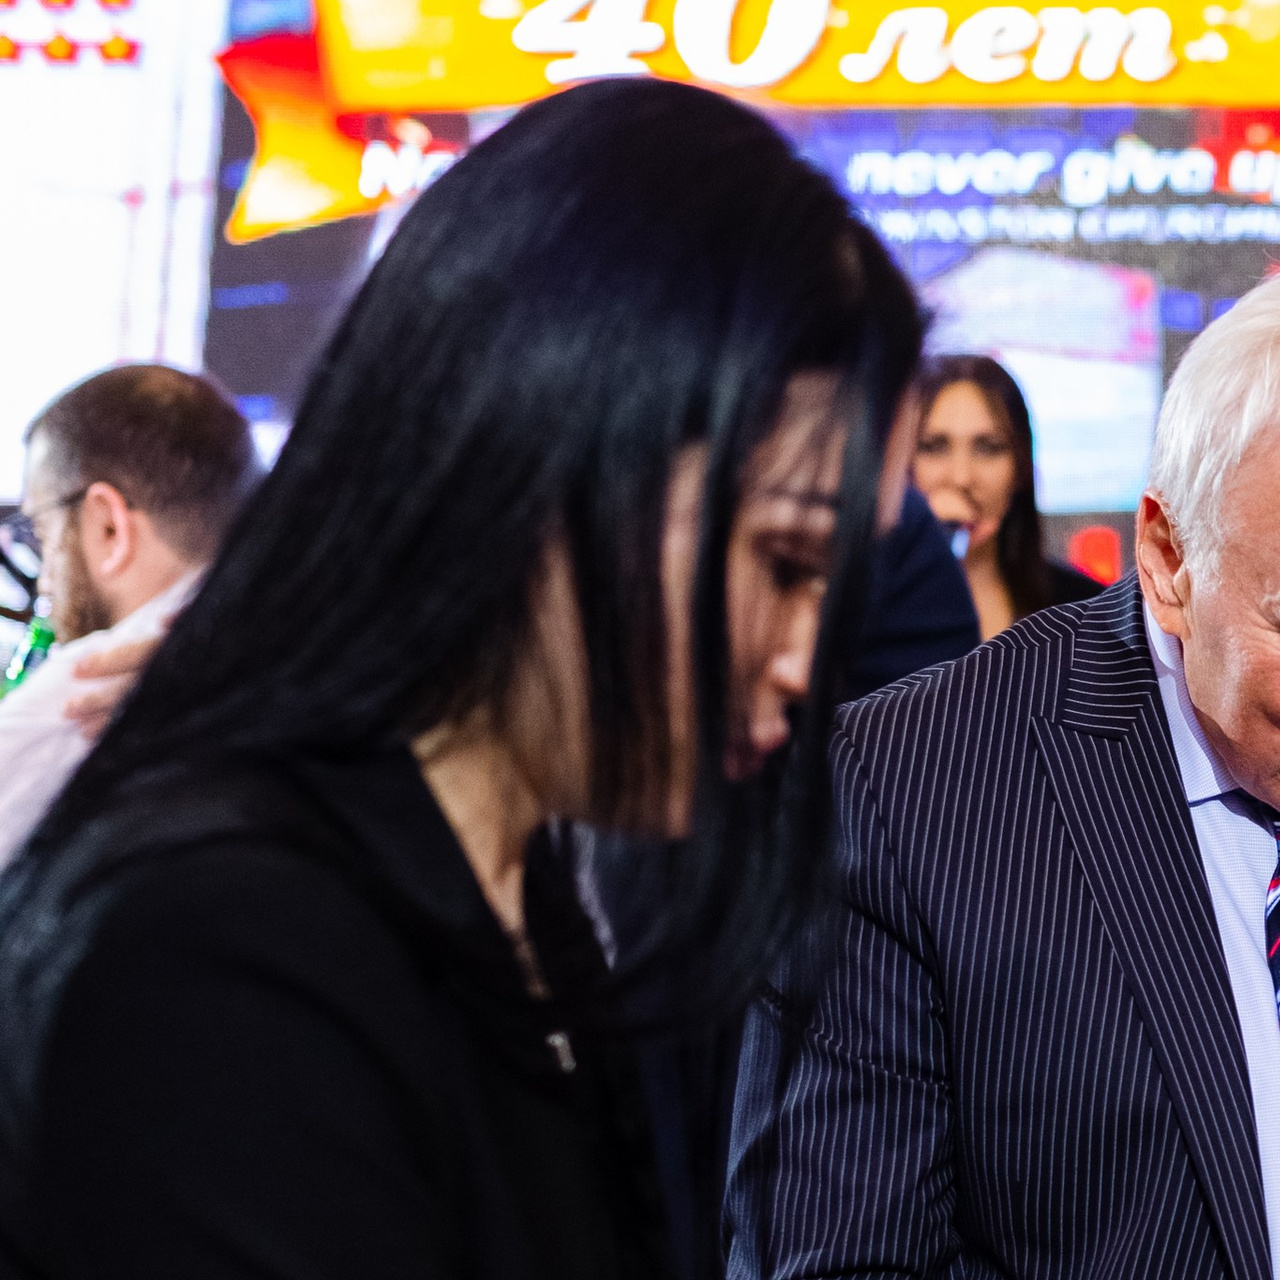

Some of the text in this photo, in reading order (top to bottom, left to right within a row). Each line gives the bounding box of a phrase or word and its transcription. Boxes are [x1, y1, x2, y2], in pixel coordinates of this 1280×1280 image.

[512, 0, 1175, 87] 40 лет
[847, 148, 1055, 195] never
[1061, 135, 1217, 207] give
